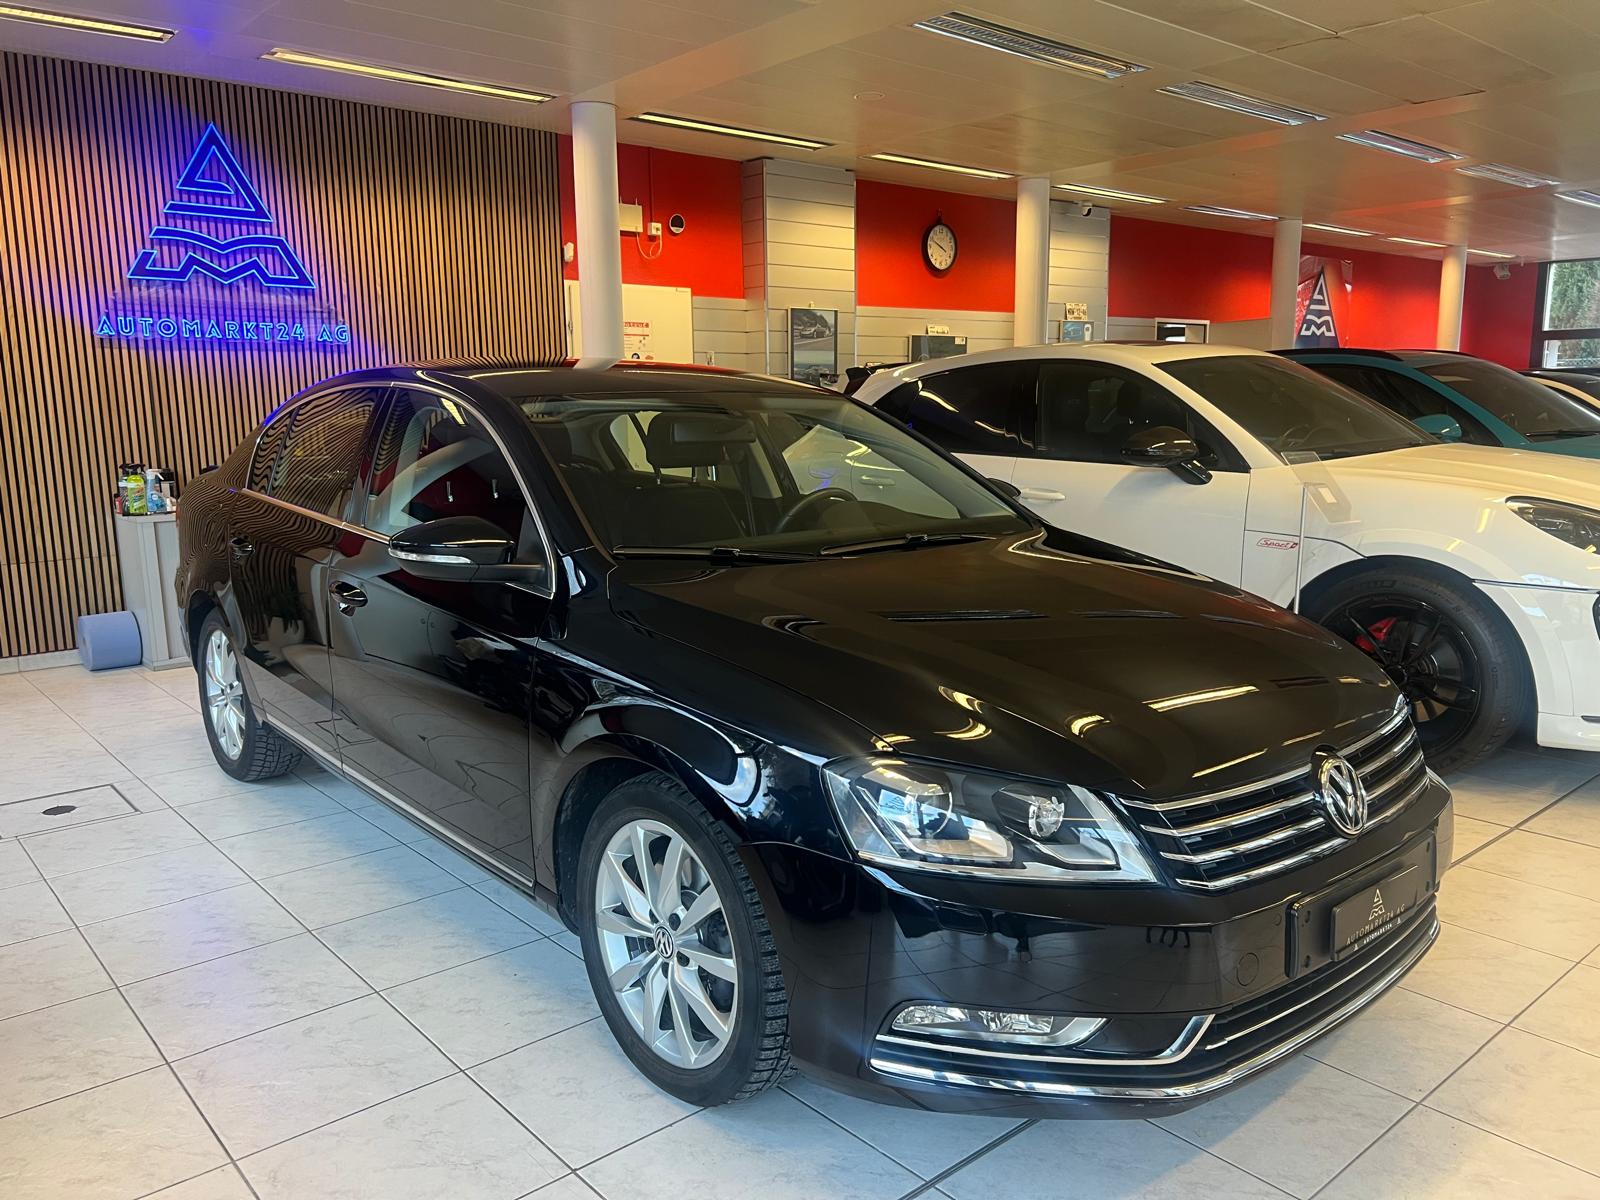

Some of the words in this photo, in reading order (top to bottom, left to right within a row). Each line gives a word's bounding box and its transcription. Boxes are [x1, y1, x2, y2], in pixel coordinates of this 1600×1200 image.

[97, 315, 305, 341] AUTOMARKT24
[317, 323, 350, 343] AG
[1346, 910, 1394, 945] AUTOMARKT24
